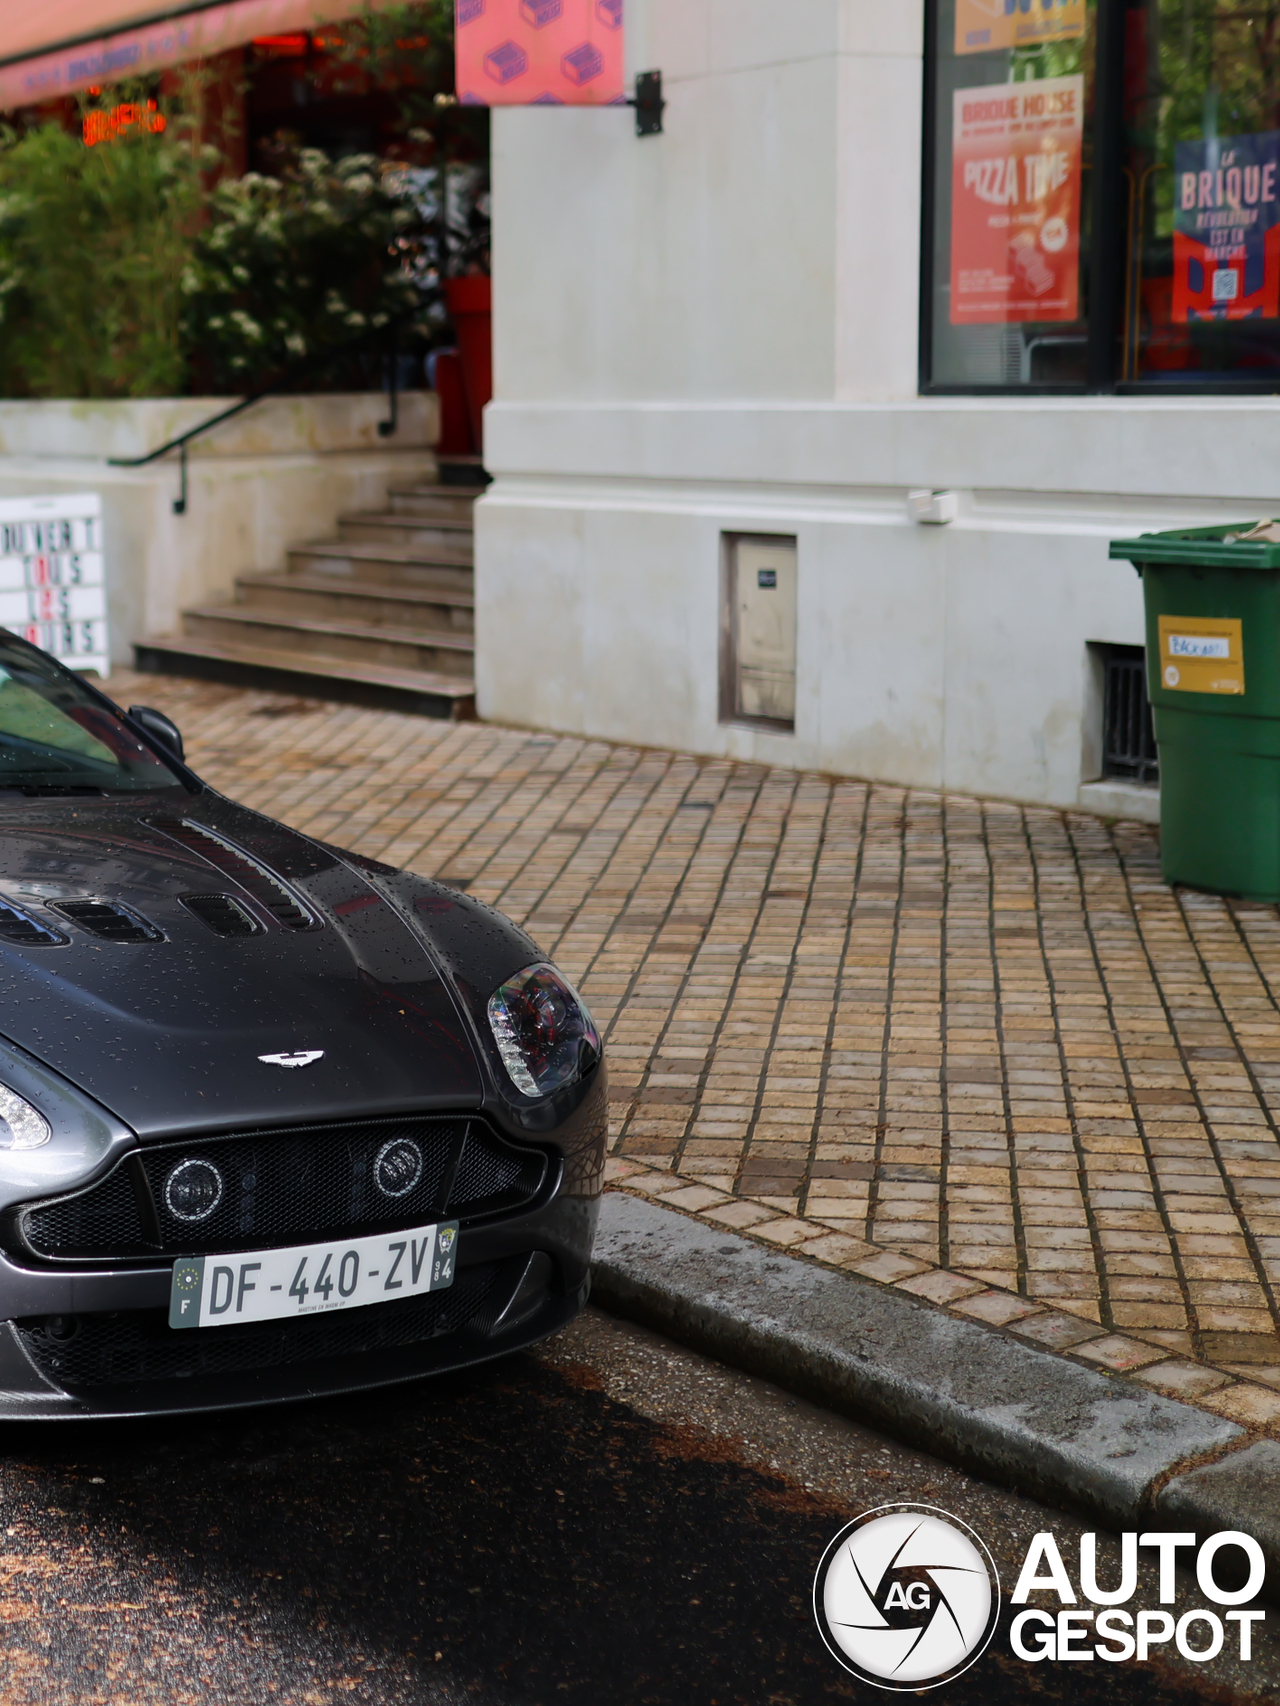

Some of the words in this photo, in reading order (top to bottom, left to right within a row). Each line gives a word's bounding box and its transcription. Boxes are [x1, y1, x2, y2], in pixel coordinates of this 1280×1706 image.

[1023, 89, 1075, 118] HOUSE
[964, 156, 1019, 206] PIZZA
[1024, 151, 1070, 203] TIME
[1180, 162, 1278, 211] BRIQUE
[0, 518, 95, 554] OUVERT
[23, 555, 83, 588] TOUS
[18, 621, 95, 654] OURS
[209, 1236, 429, 1315] DF-440-ZV
[180, 1299, 191, 1315] F
